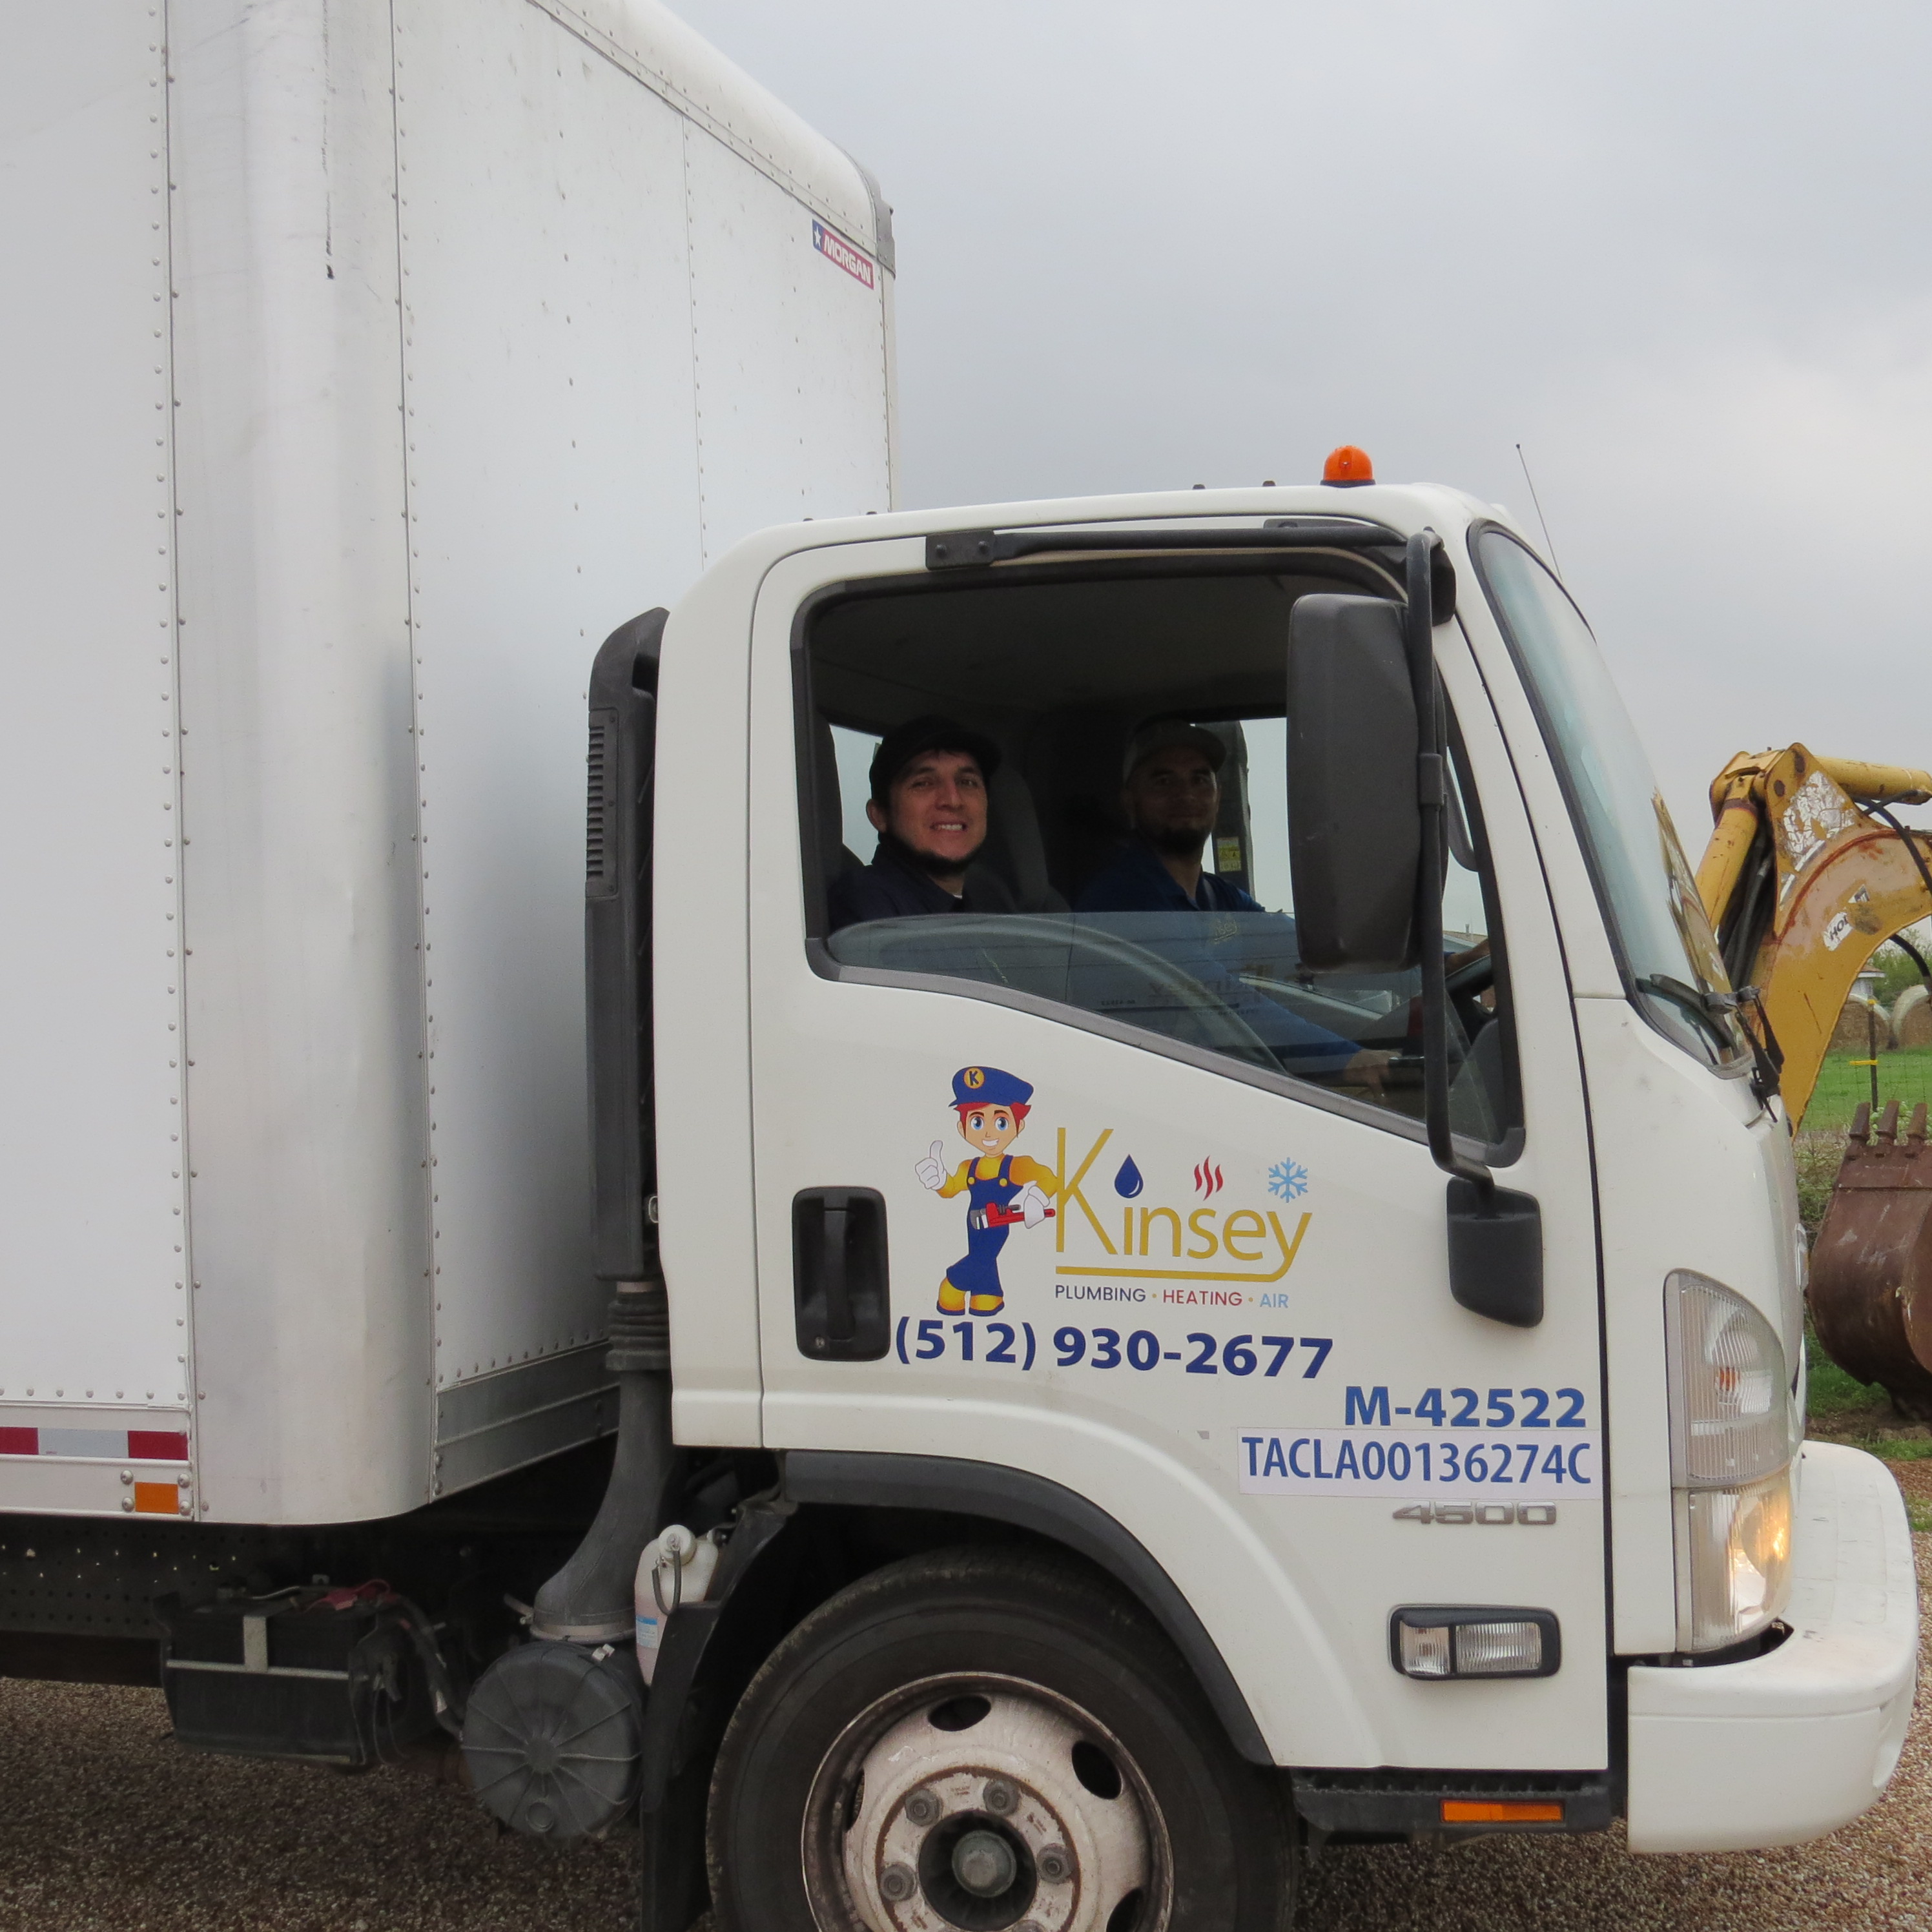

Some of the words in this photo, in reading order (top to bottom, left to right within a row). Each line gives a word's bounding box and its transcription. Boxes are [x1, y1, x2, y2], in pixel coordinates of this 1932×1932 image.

[823, 234, 872, 285] MORGAN
[969, 1071, 979, 1086] K
[1055, 1127, 1312, 1282] Kinsey
[1055, 1284, 1146, 1302] PLUMBING
[1163, 1289, 1243, 1307] HEATING
[1260, 1293, 1289, 1308] AIR
[896, 1316, 1036, 1370] (512)
[1054, 1327, 1333, 1379] 930-2677
[1345, 1386, 1586, 1428] M-42522
[1242, 1436, 1591, 1484] TACLA00136274C
[1392, 1501, 1557, 1525] 4500
